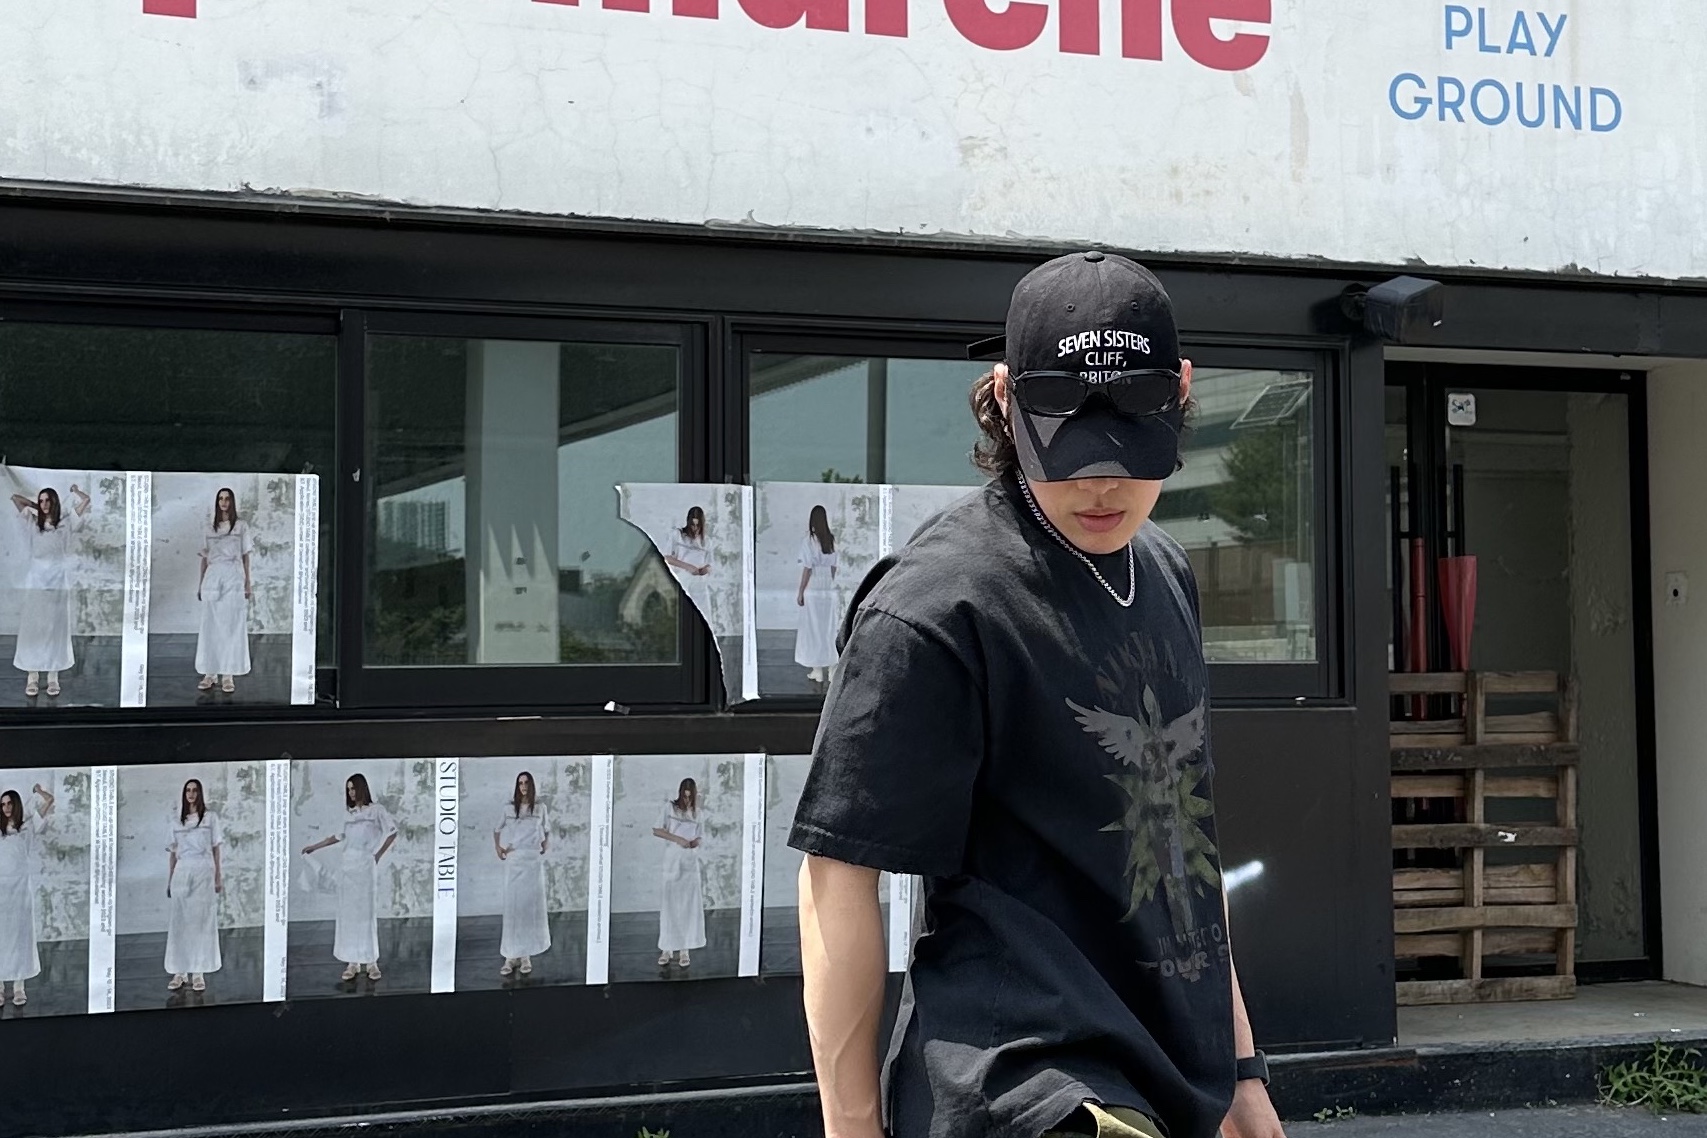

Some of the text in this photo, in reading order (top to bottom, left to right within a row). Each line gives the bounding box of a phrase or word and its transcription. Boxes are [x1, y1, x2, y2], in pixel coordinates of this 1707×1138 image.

[1444, 5, 1568, 57] PLAY
[1388, 72, 1622, 132] GROUND
[1057, 329, 1150, 357] SEVEN SISTERS
[1085, 351, 1127, 367] CLIFF,
[437, 761, 458, 899] STUDIO TABLE
